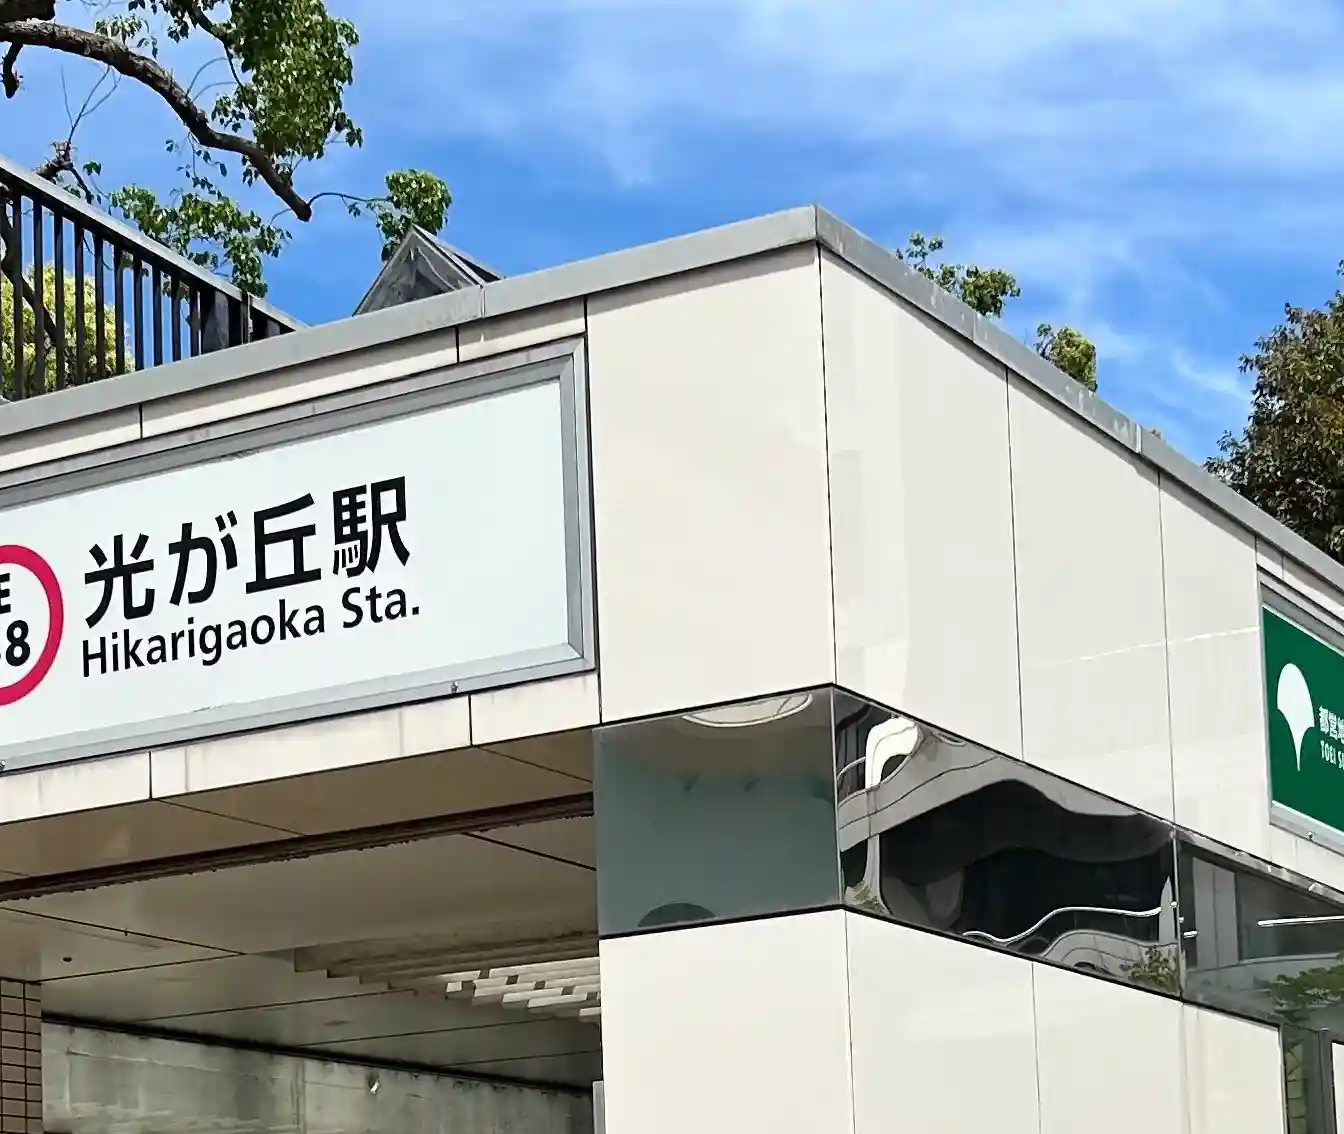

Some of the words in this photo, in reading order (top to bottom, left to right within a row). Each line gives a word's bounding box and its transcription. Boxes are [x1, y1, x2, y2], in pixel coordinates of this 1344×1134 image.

[84, 475, 411, 630] 光が丘駅
[82, 598, 326, 678] Hikarigaoka
[341, 586, 421, 629] Sta.
[1320, 740, 1337, 766] TOEI
